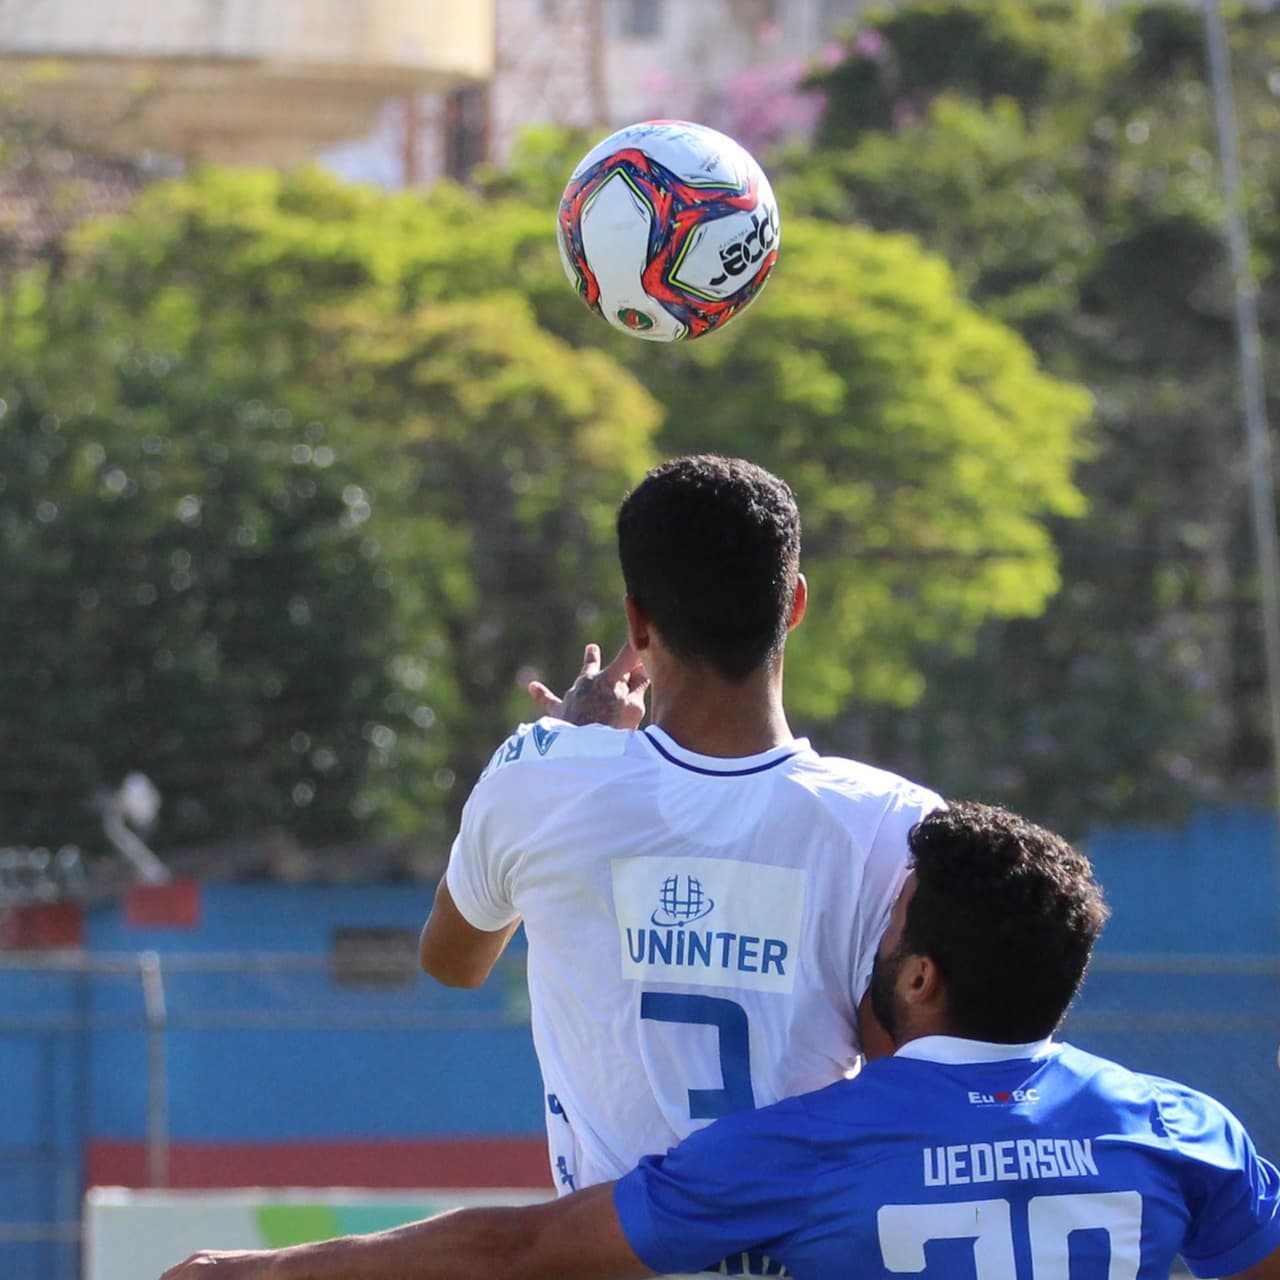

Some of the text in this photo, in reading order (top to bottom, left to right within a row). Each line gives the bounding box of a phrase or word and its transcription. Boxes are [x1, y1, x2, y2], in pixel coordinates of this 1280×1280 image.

[709, 204, 778, 286] pper
[626, 927, 789, 976] UNINTER
[968, 1091, 995, 1104] Eu
[923, 1138, 1099, 1187] UEDERSON
